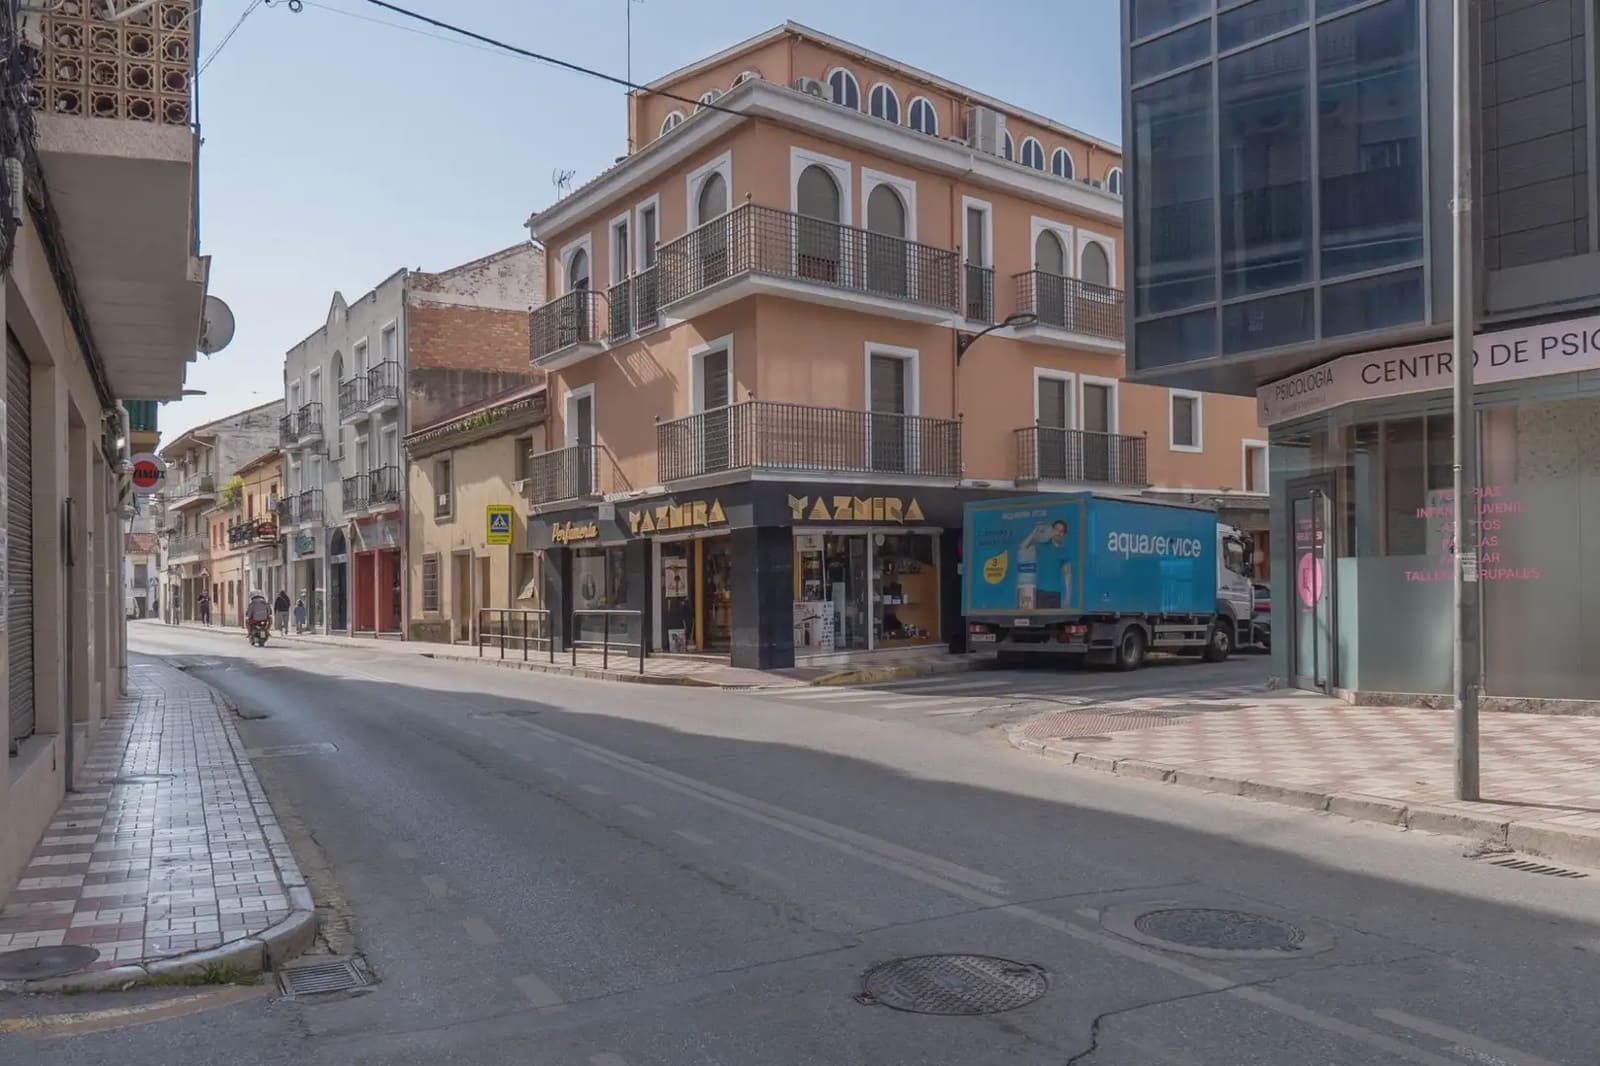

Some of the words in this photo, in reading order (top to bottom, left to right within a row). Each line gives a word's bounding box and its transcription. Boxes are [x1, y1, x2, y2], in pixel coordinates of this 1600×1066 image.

[1361, 349, 1479, 385] CENTR
[1491, 340, 1529, 367] DE
[1107, 531, 1202, 560] aquaservice
